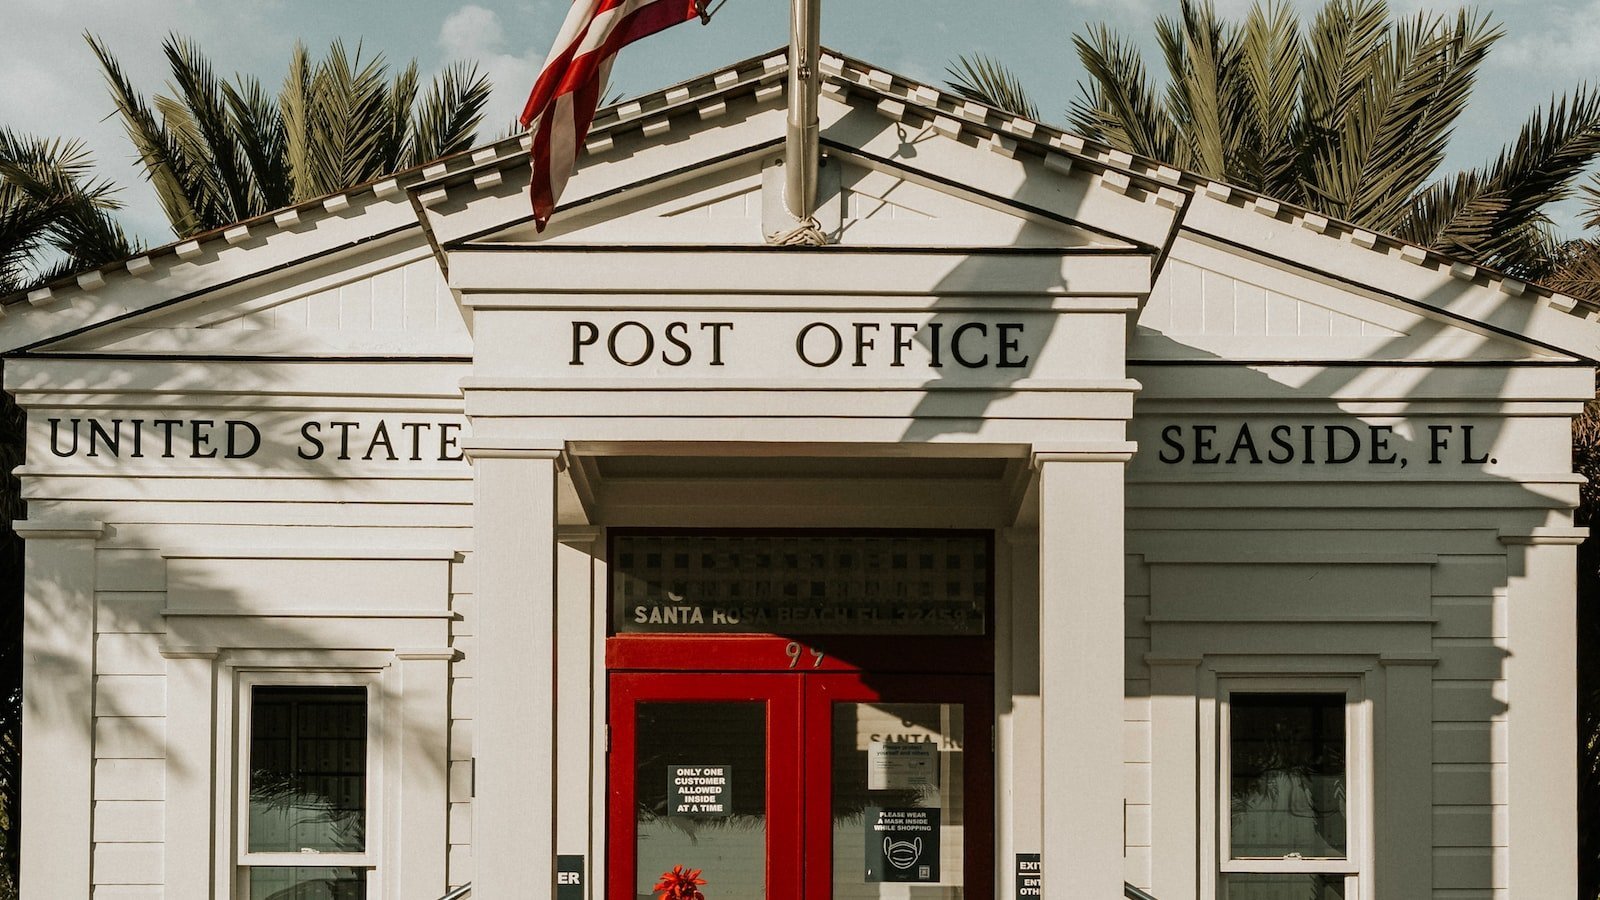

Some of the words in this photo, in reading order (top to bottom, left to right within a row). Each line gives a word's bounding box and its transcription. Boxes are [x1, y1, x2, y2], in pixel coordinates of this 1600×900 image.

[568, 320, 734, 367] POST
[795, 321, 1029, 368] OFFICE
[48, 417, 262, 459] UNITED
[1158, 422, 1408, 469] SEASIDE,
[1427, 425, 1498, 465] FL.
[634, 605, 704, 624] SANTA
[674, 777, 726, 785] CUSTOMER
[684, 795, 716, 803] INSIDE
[691, 804, 699, 812] A
[700, 804, 723, 812] TIME
